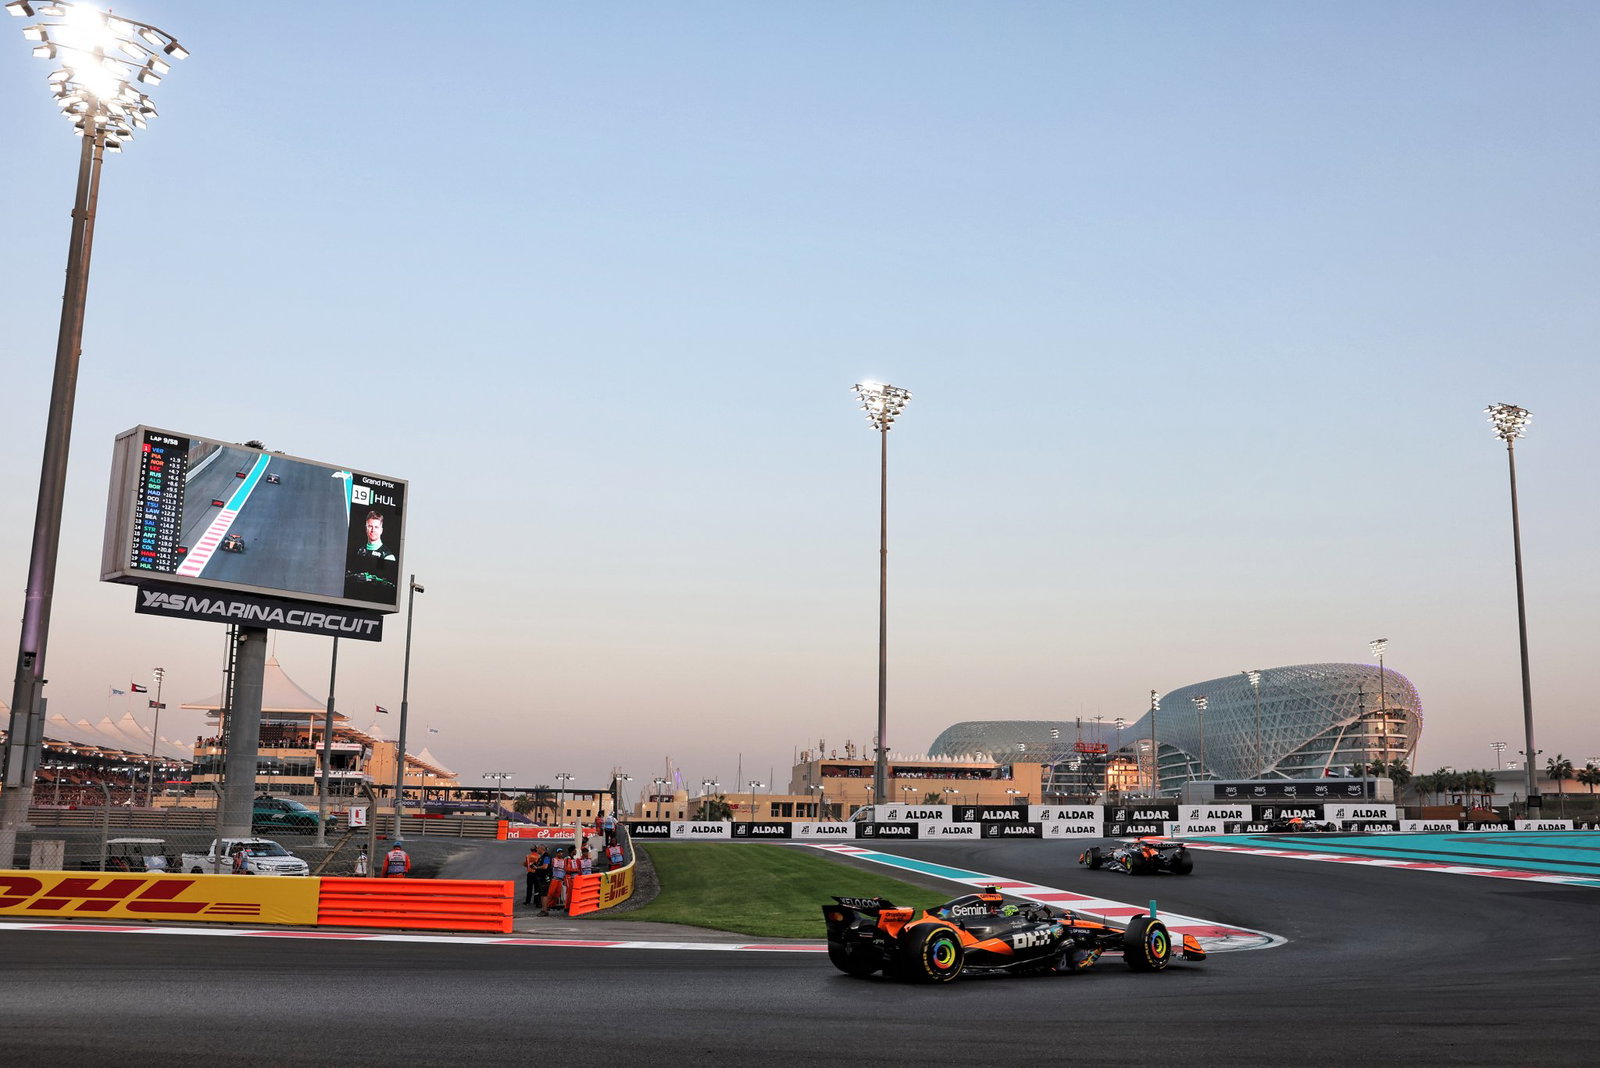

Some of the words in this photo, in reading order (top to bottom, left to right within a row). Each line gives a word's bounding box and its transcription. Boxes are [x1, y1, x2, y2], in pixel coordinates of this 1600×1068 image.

[362, 476, 381, 486] Grand
[382, 480, 394, 489] Prix
[354, 490, 368, 500] 19
[374, 494, 396, 506] HUL
[905, 810, 943, 819] ALDAR
[982, 811, 1020, 820] ALDAR
[1058, 811, 1094, 819] ALDAR
[1133, 811, 1169, 820] ALDAR
[1207, 810, 1242, 818] ALDAR
[1280, 809, 1316, 818] ALDAR
[1352, 810, 1386, 818] ALDAR
[636, 825, 668, 833] ALDAR
[752, 826, 784, 834] ALDAR
[816, 826, 848, 834] ALDAR
[879, 826, 911, 834] ALDAR
[1004, 826, 1035, 834] ALDAR
[952, 903, 988, 916] Gemini
